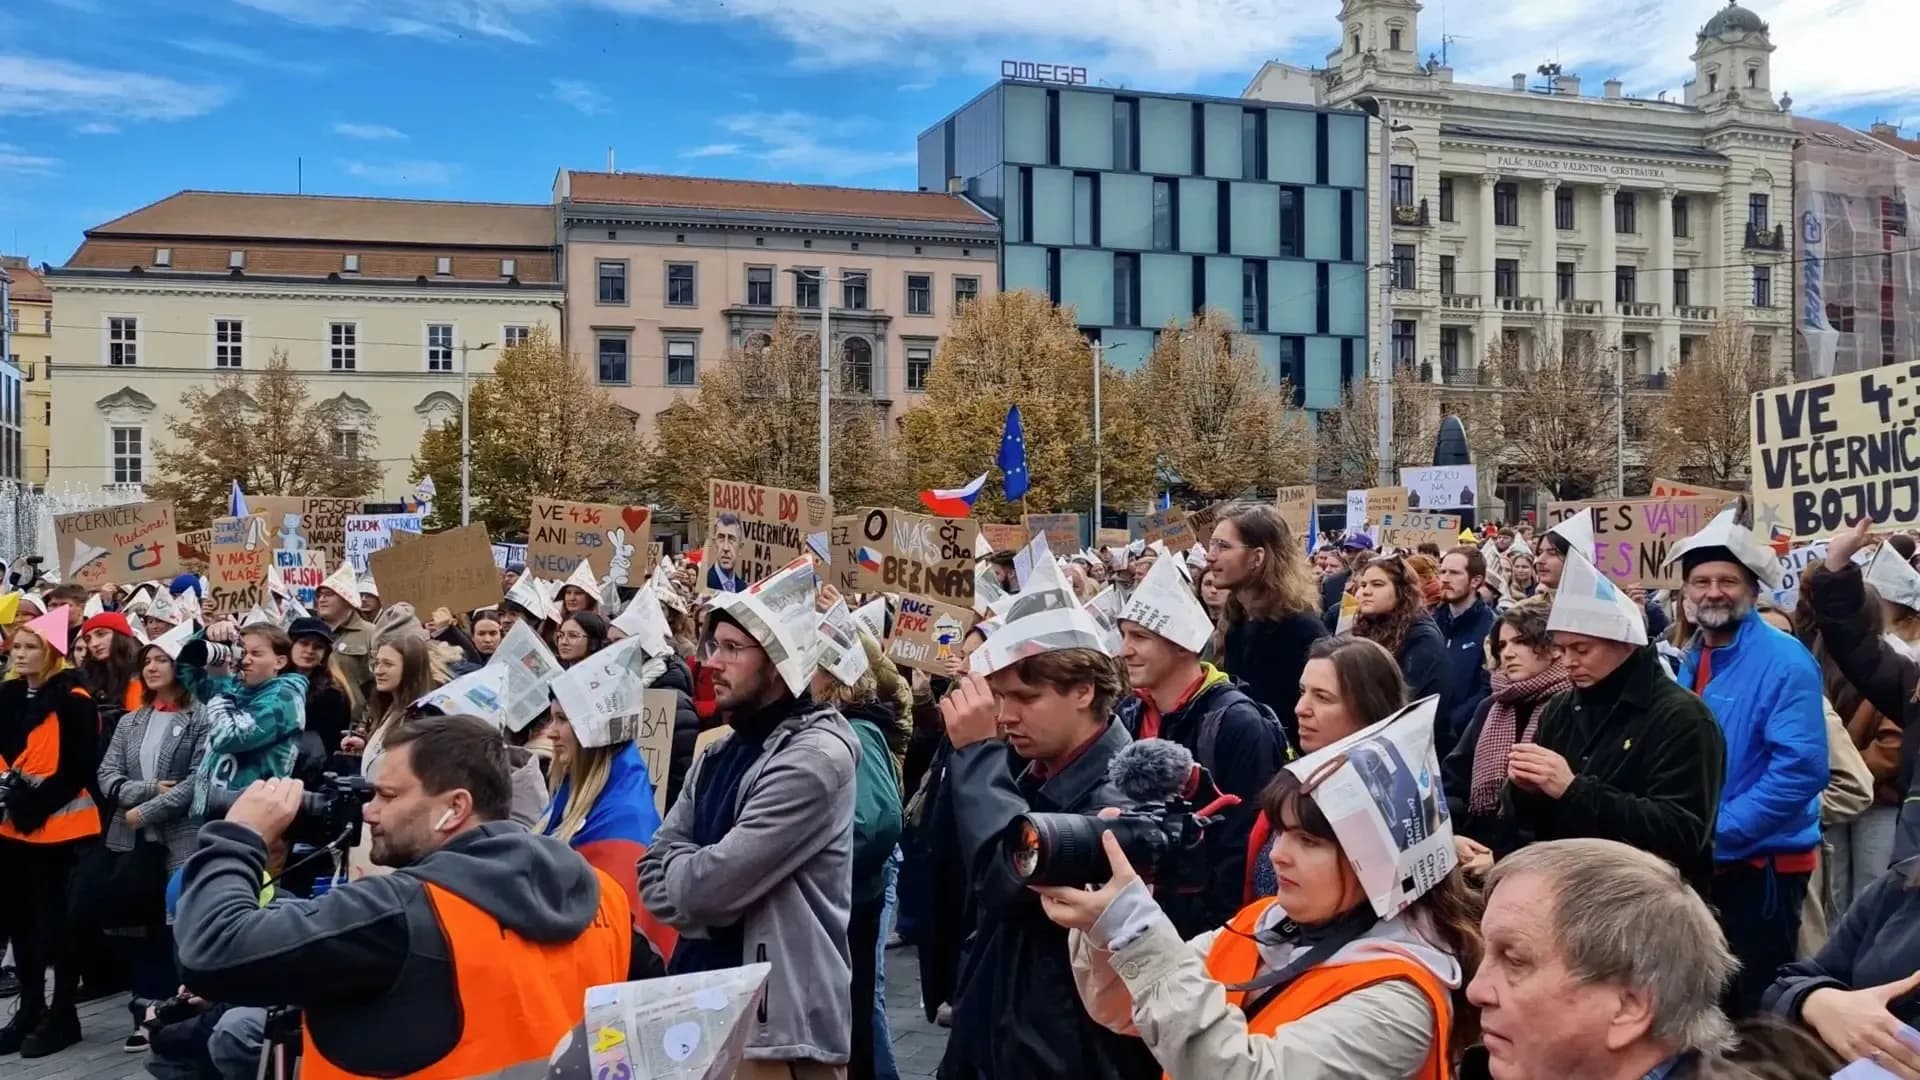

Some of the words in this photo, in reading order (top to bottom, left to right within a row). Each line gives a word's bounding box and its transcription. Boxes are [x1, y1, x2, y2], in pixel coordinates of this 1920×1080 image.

[1001, 60, 1087, 84] OMEGA
[1498, 156, 1522, 167] PALÁC
[1527, 158, 1559, 170] NADACE
[1563, 160, 1607, 174] VALENTINA
[1775, 383, 1838, 441] VE
[309, 499, 362, 514] PEJSEK
[539, 505, 564, 520] VE
[778, 493, 799, 522] DO
[1793, 476, 1920, 537] BOJUJ
[302, 514, 313, 529] S
[864, 509, 888, 541] O
[939, 519, 965, 541] ČT
[363, 538, 377, 549] ANI
[535, 526, 567, 545] ANI
[575, 531, 603, 547] BOB
[216, 554, 225, 566] V
[754, 544, 772, 562] NA
[740, 560, 782, 584] HRA
[882, 555, 922, 595] BEZ
[924, 560, 975, 598] NÁS
[901, 598, 934, 616] RUCE
